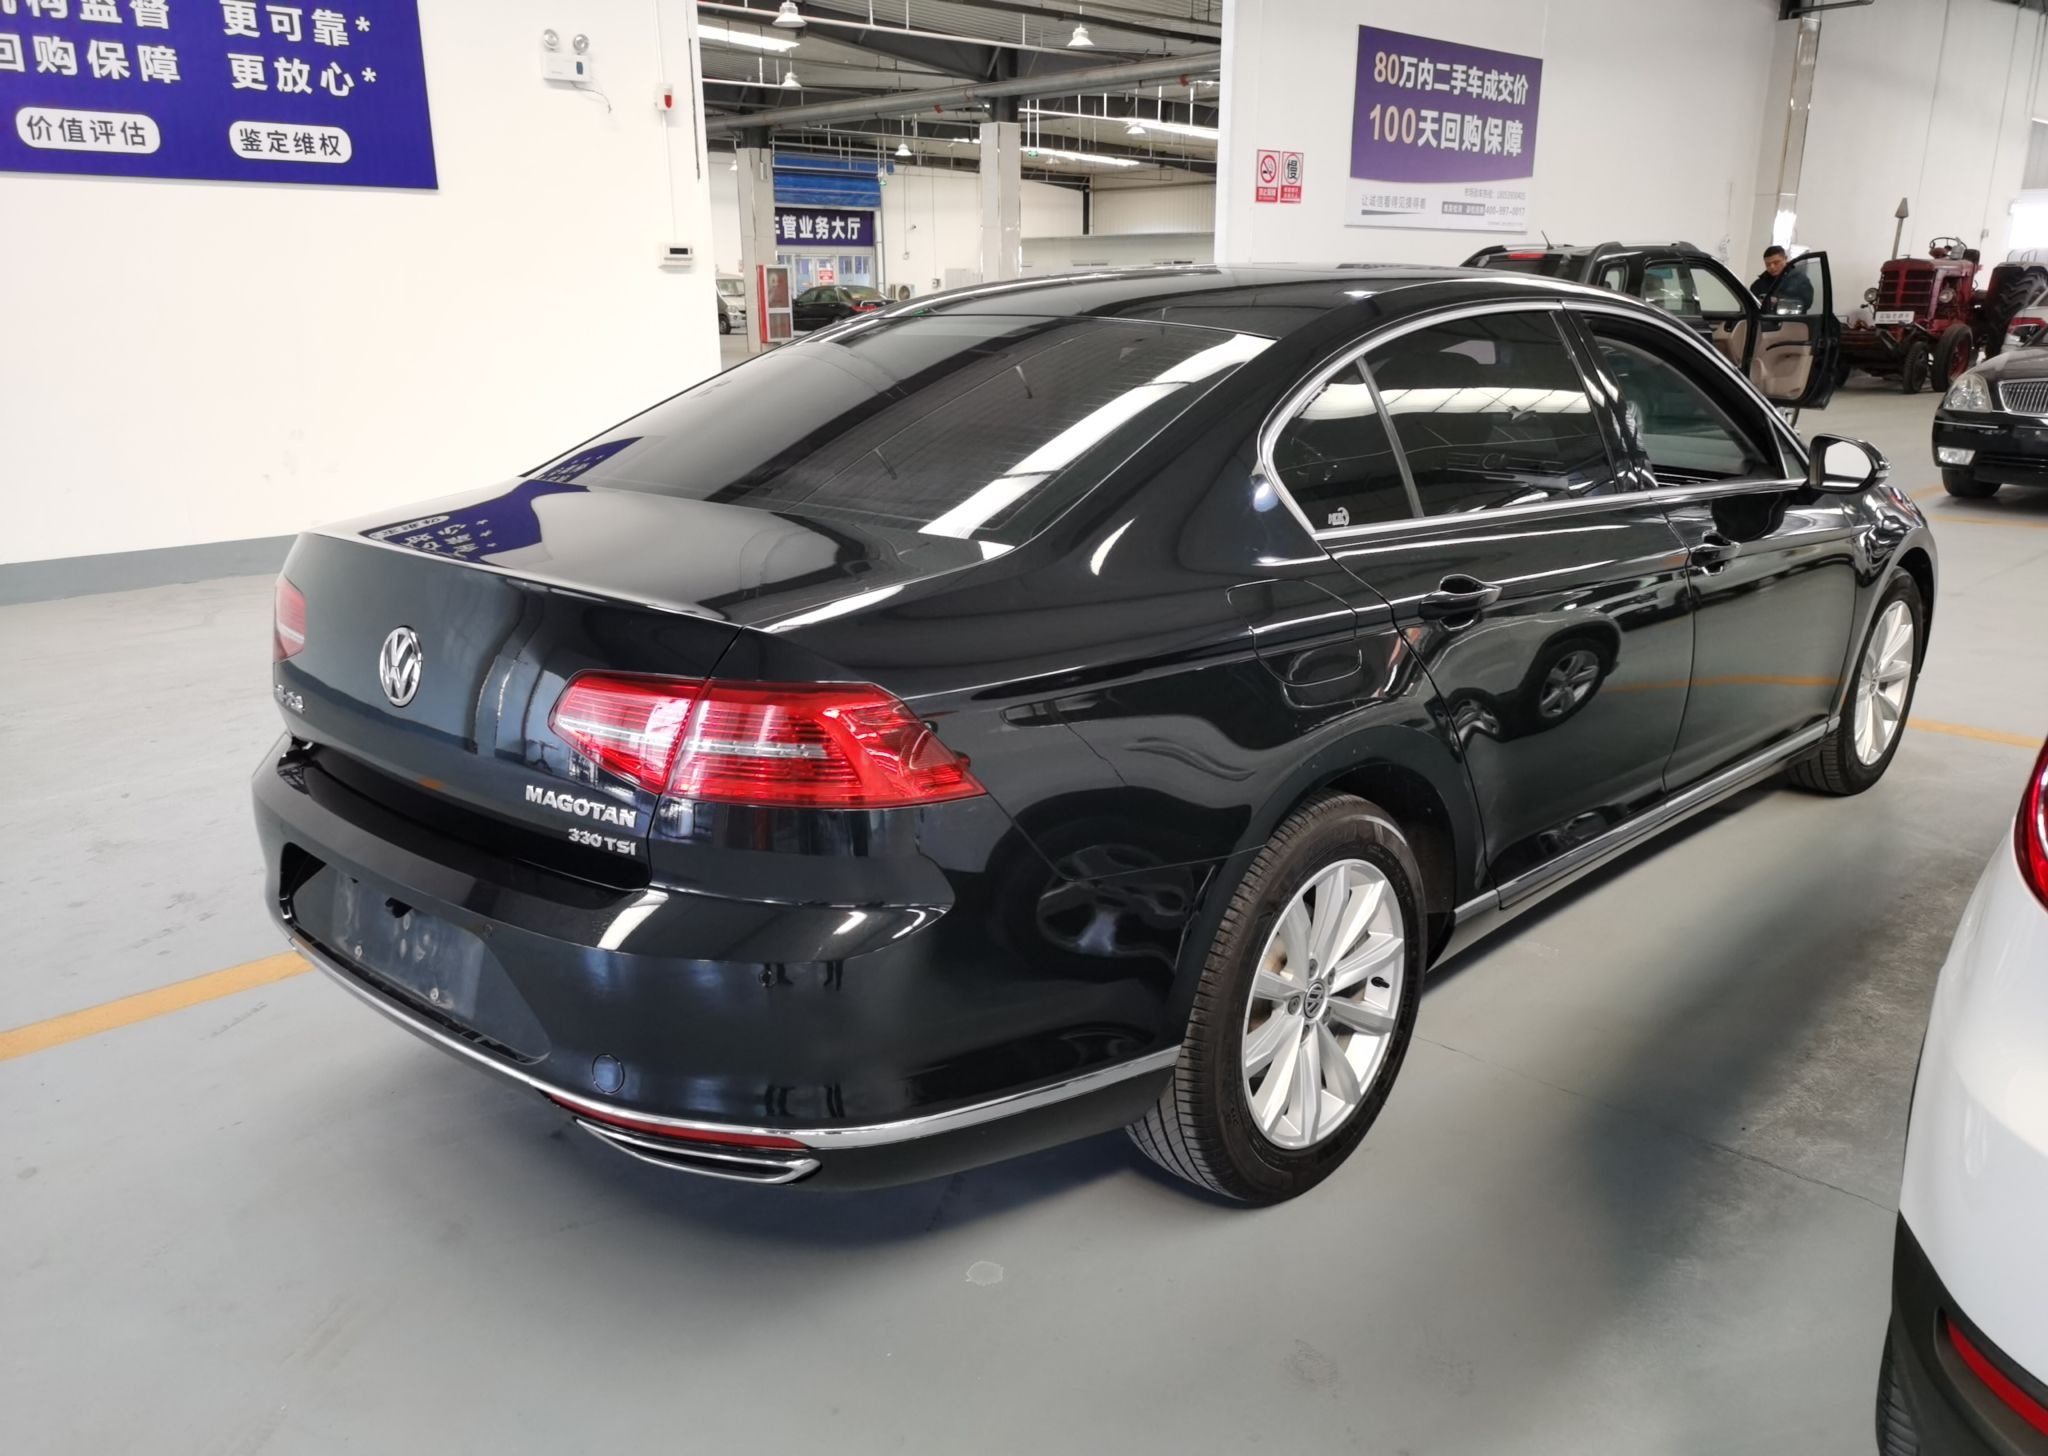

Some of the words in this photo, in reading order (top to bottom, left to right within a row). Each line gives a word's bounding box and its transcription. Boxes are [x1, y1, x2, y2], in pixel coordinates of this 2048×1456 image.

[0, 0, 170, 30] 监督
[0, 33, 181, 84] 回购保障
[1373, 51, 1529, 105] 80万内二手车成交价
[26, 114, 147, 147] 价值评估
[239, 128, 342, 157] 鉴定维权
[1369, 103, 1524, 157] 100天回购保障
[525, 785, 637, 828] MAGOTAN
[568, 828, 602, 848] 330
[604, 837, 637, 856] TSI
